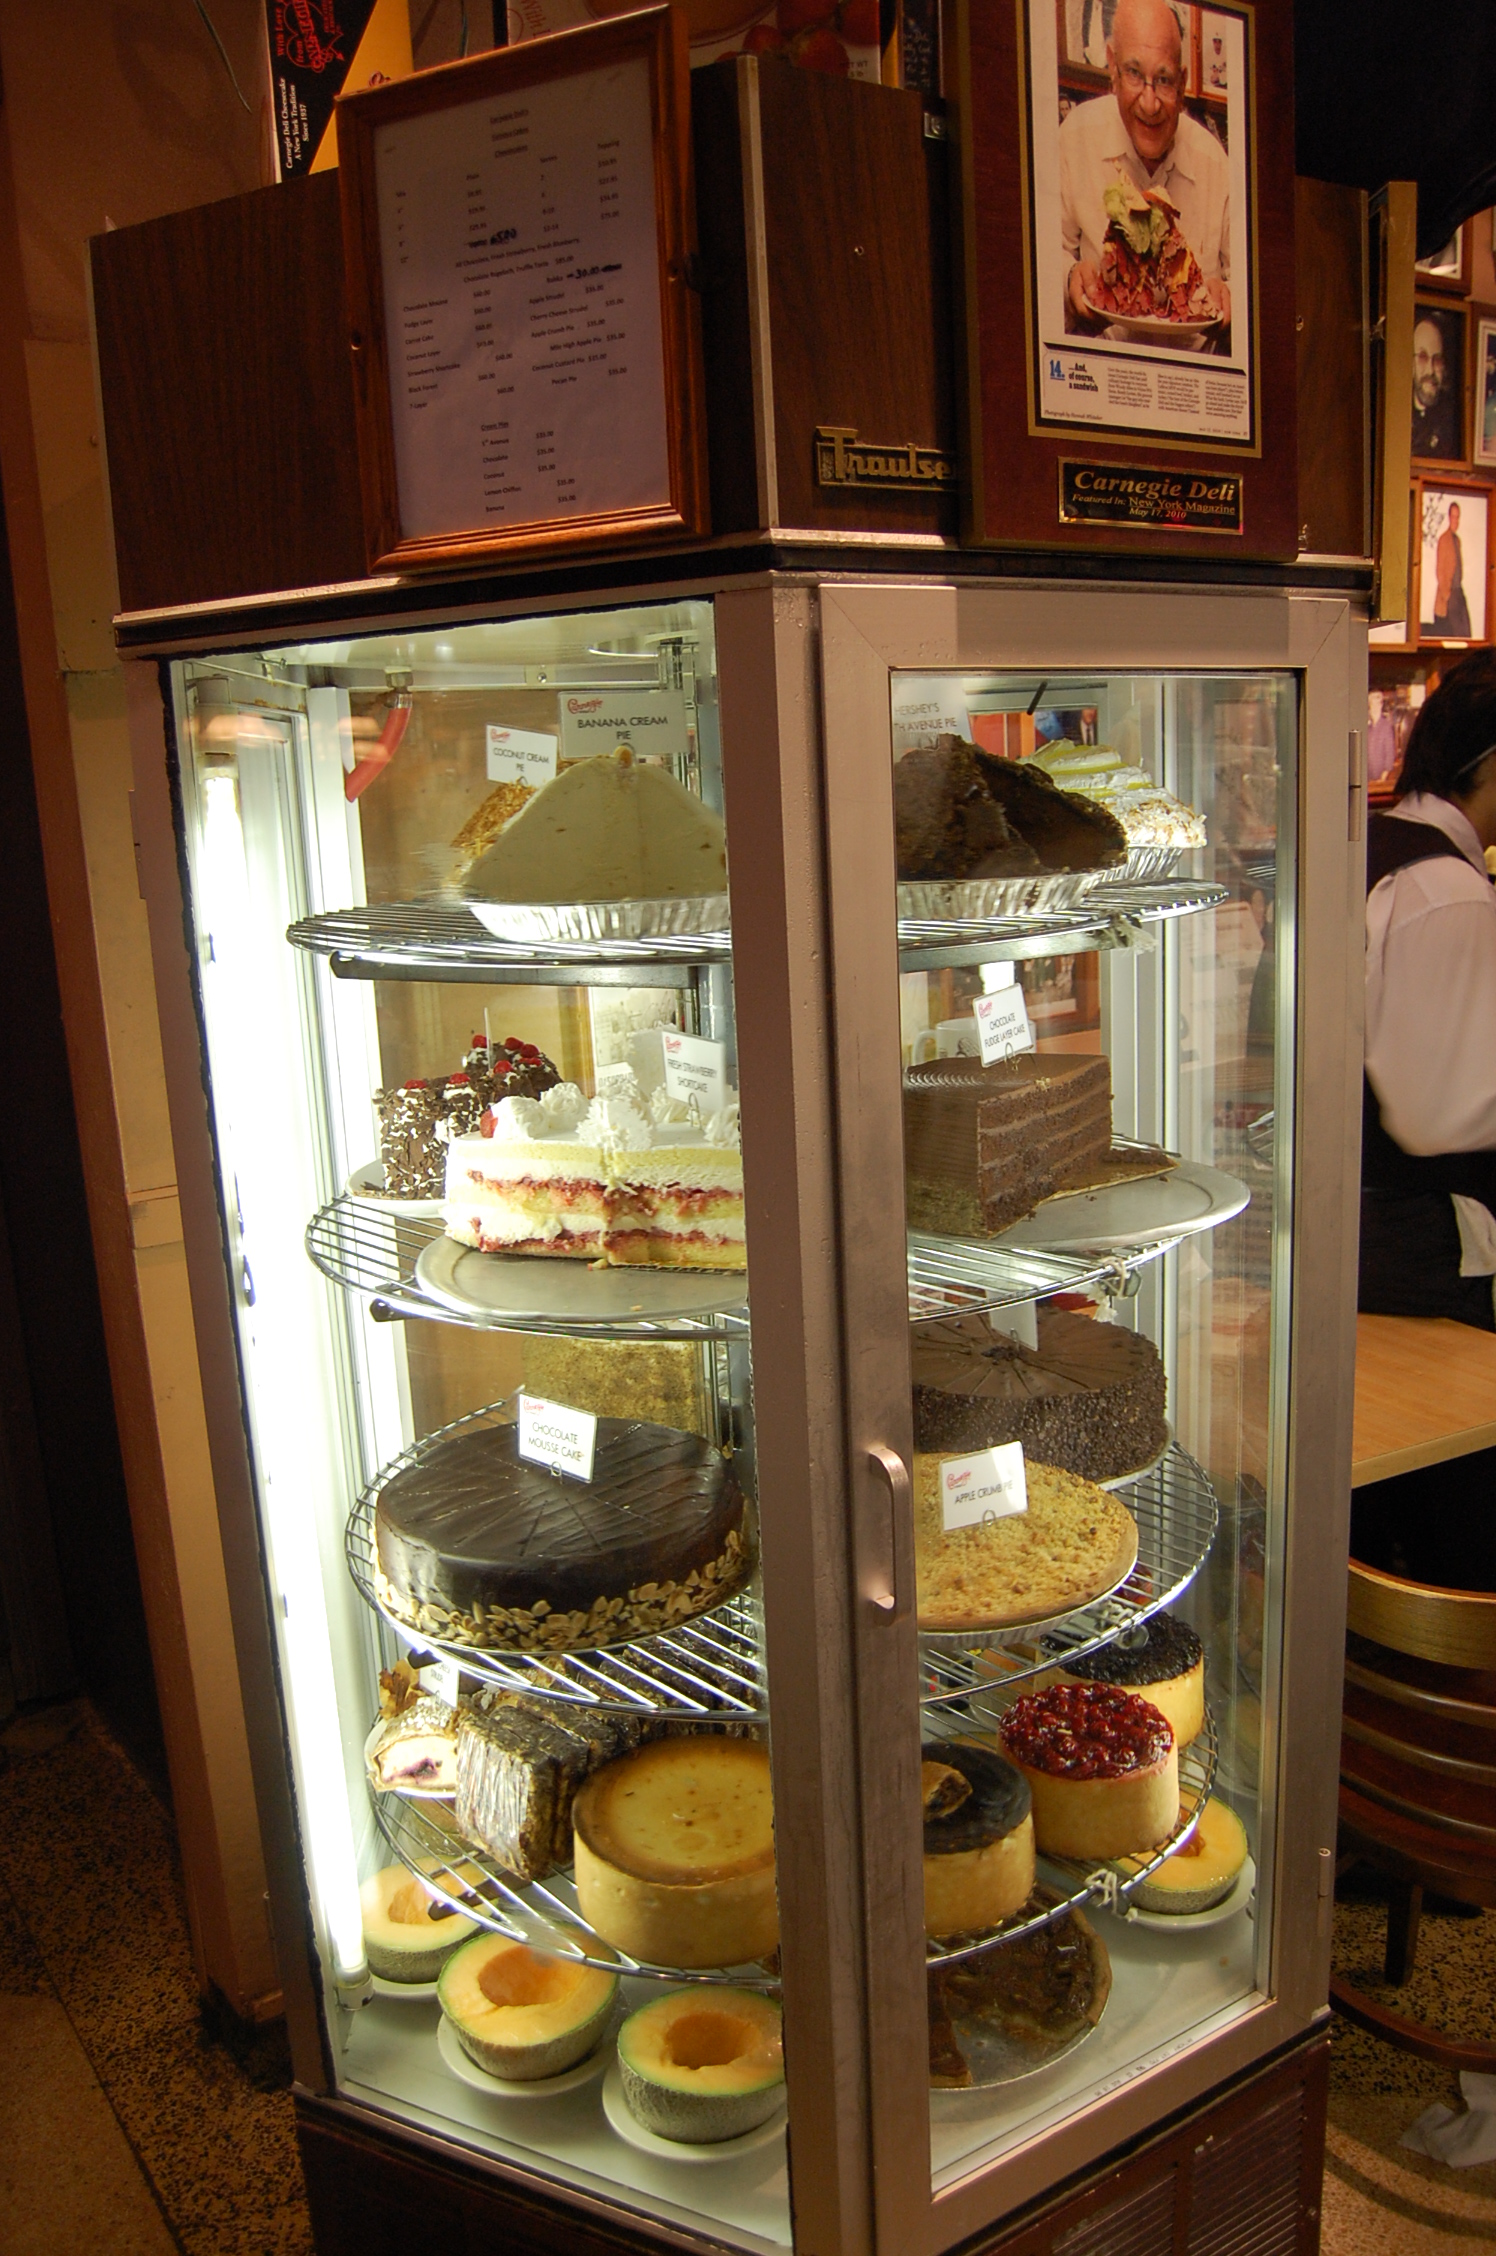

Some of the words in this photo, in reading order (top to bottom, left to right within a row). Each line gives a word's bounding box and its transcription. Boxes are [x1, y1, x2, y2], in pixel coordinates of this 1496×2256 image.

[276, 7, 284, 31] Love
[276, 34, 284, 56] With
[296, 40, 304, 62] from
[280, 77, 288, 119] Cheesecake
[290, 85, 298, 118] Tradition
[300, 104, 308, 120] 1937
[282, 121, 290, 136] Deli
[292, 119, 300, 136] York
[302, 122, 310, 142] Since
[284, 136, 294, 168] Carnegie
[294, 136, 302, 152] New
[295, 152, 302, 160] A
[1068, 372, 1074, 380] of
[1075, 374, 1095, 383] course,
[1073, 383, 1098, 392] sandwich
[1074, 471, 1183, 499] Carnegie
[1187, 481, 1235, 501] Deli
[1072, 494, 1112, 505] Featured
[1114, 496, 1126, 506] In:
[1129, 496, 1154, 508] New
[1156, 500, 1184, 510] York
[1185, 502, 1236, 515] Magazine
[1129, 506, 1149, 518] May
[1165, 509, 1187, 519] 2010
[894, 702, 940, 716] HERSHEY'S
[578, 717, 628, 728] BANANA
[629, 716, 668, 726] CREAM
[908, 718, 943, 731] AVENUE
[944, 717, 957, 728] PIE
[616, 730, 632, 740] PIE
[493, 748, 525, 760] COCONUT
[526, 751, 550, 764] CREAM
[516, 763, 525, 772] PIE
[989, 1012, 1016, 1030] CHOCOLATE
[984, 1034, 1000, 1048] FUDGE
[1000, 1029, 1014, 1042] LAYER
[1013, 1024, 1026, 1036] CAKE
[532, 1422, 578, 1445] CHOCOLATE
[528, 1437, 559, 1454] MOUSSE
[560, 1446, 582, 1462] CAKE
[954, 1490, 976, 1504] APPLE
[977, 1484, 1002, 1498] CRUMB
[1003, 1480, 1013, 1492] PIE
